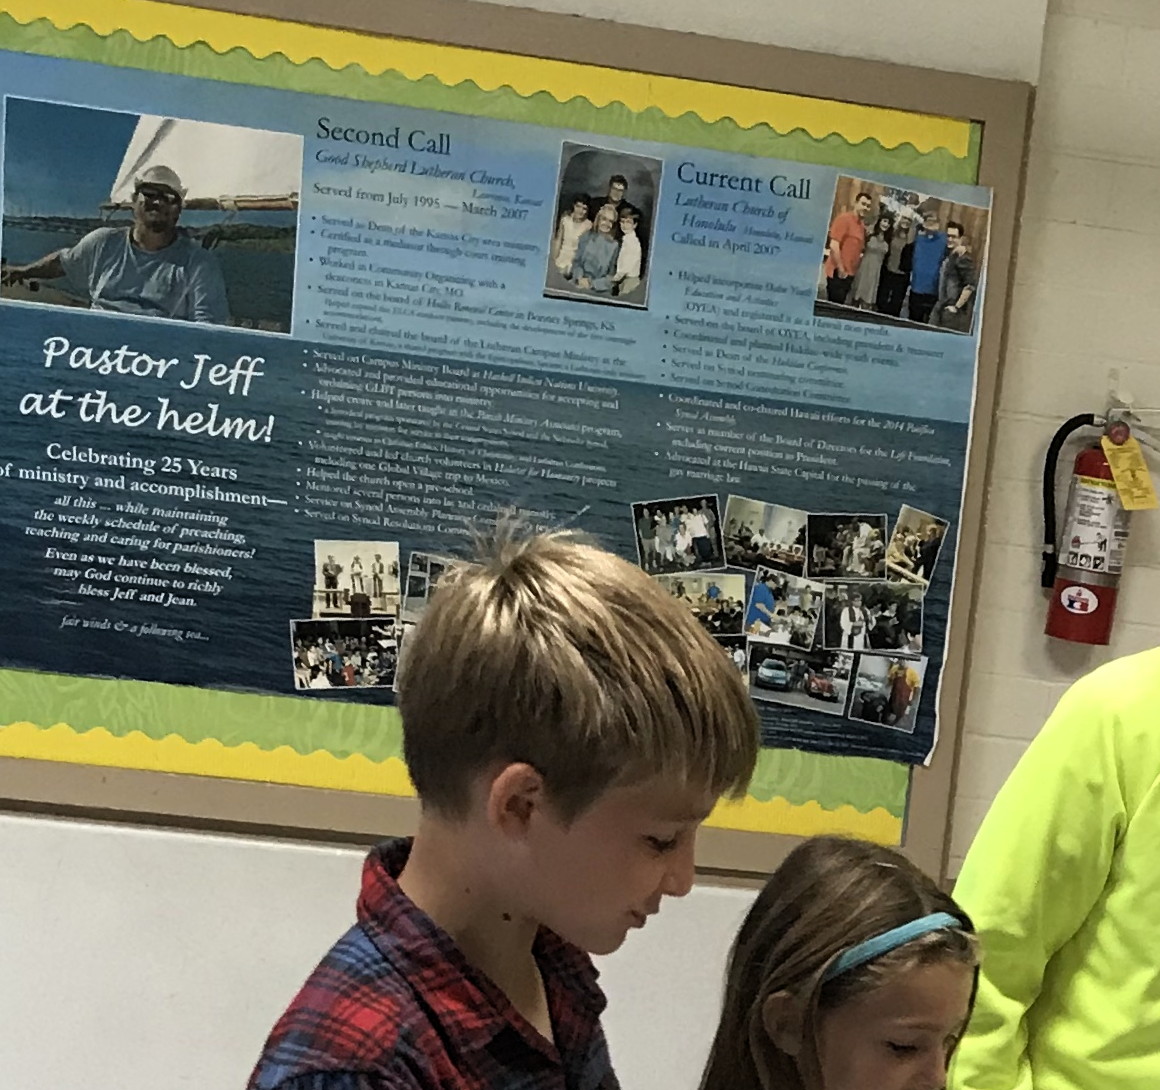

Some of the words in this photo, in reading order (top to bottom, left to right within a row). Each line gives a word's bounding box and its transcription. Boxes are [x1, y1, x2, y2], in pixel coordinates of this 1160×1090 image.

[317, 117, 399, 149] Second
[408, 129, 451, 155] Call
[315, 149, 349, 167] Good
[355, 153, 407, 176] Shepherd
[410, 159, 466, 182] Lutheran
[470, 170, 516, 190] Church,
[677, 161, 762, 191] Current
[770, 175, 810, 199] Call
[313, 183, 353, 198] Served
[356, 186, 385, 203] from
[386, 190, 409, 208] July
[462, 201, 498, 218] March
[501, 206, 529, 221] 2007
[675, 193, 727, 211] Lutheran
[732, 200, 774, 217] Church
[777, 206, 790, 224] of
[681, 213, 736, 231] Honolulu
[671, 232, 705, 246] Called
[708, 238, 719, 248] in
[722, 239, 749, 255] April
[43, 336, 179, 380] Pastor
[180, 353, 265, 396] Jeff
[20, 385, 72, 419] at
[78, 389, 151, 428] the
[157, 399, 274, 441] helm!
[19, 464, 88, 488] ministry
[94, 473, 124, 489] and
[46, 443, 156, 473] Celebrating
[161, 456, 182, 472] 25
[187, 459, 237, 479] Years
[34, 508, 54, 521] the
[58, 511, 98, 527] weekly
[104, 515, 160, 531] schedule
[162, 522, 178, 534] of
[54, 494, 71, 506] all
[73, 495, 96, 509] this
[116, 500, 148, 514] while
[151, 505, 228, 525] maintaining
[83, 530, 107, 543] and
[110, 533, 150, 549] caring
[152, 538, 171, 550] for
[172, 540, 255, 560] parishioners!
[44, 547, 76, 560] Even
[80, 553, 94, 562] as
[98, 555, 114, 565] we
[118, 555, 147, 568] have
[150, 558, 180, 571] been
[183, 562, 232, 578] blessed,
[53, 568, 80, 580] may
[84, 567, 111, 581] God
[114, 571, 169, 587] continue
[172, 579, 184, 589] to
[187, 579, 223, 596] richly
[78, 583, 109, 597] bless
[110, 586, 138, 602] Jeff
[139, 590, 164, 603] and
[164, 593, 196, 608] Jean.
[60, 615, 80, 628] fair
[83, 617, 110, 630] winds
[114, 621, 128, 631] &
[137, 622, 183, 641] following
